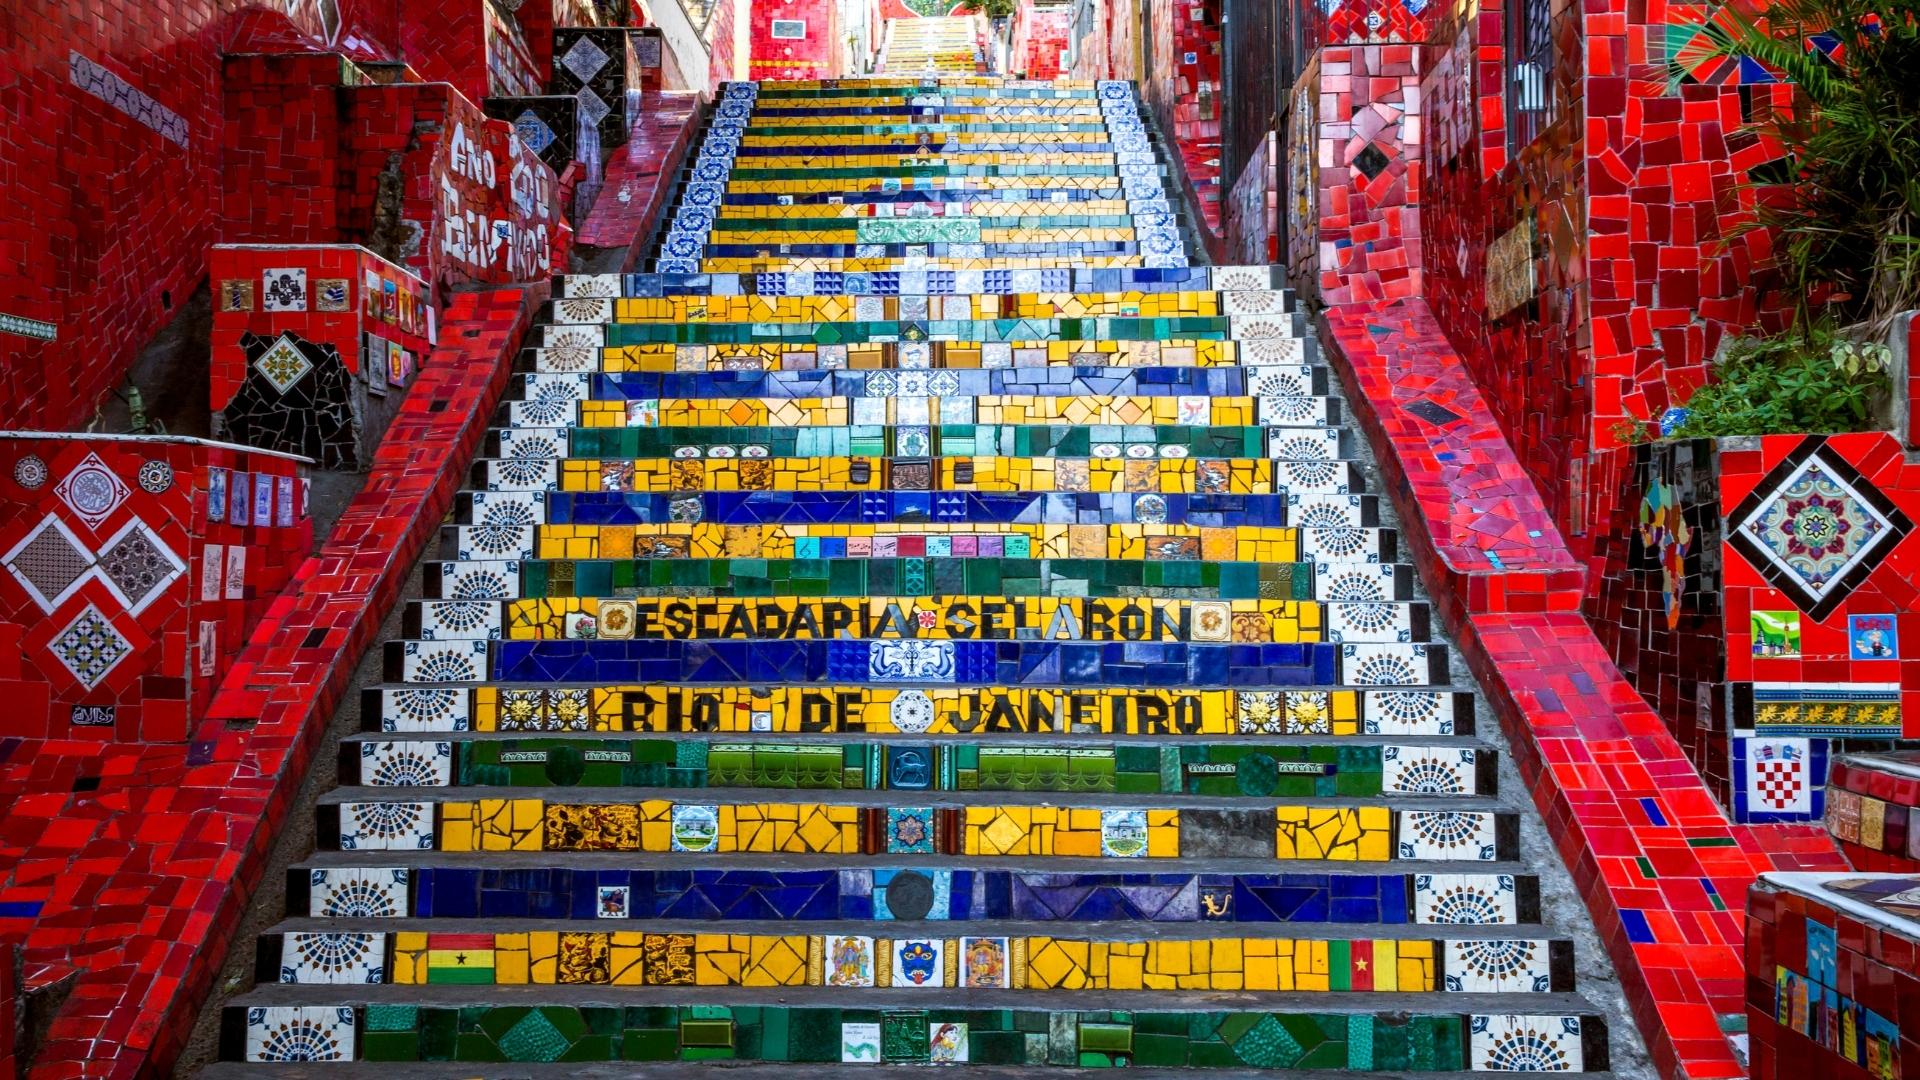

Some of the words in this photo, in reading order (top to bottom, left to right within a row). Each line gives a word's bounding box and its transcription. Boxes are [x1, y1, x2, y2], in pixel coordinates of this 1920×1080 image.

[451, 122, 496, 189] ANO
[636, 602, 916, 639] ESCADARIA
[945, 603, 1191, 641] SELARON
[623, 691, 719, 733] RIO
[801, 692, 866, 733] DE
[950, 692, 1202, 734] JANEIRO
